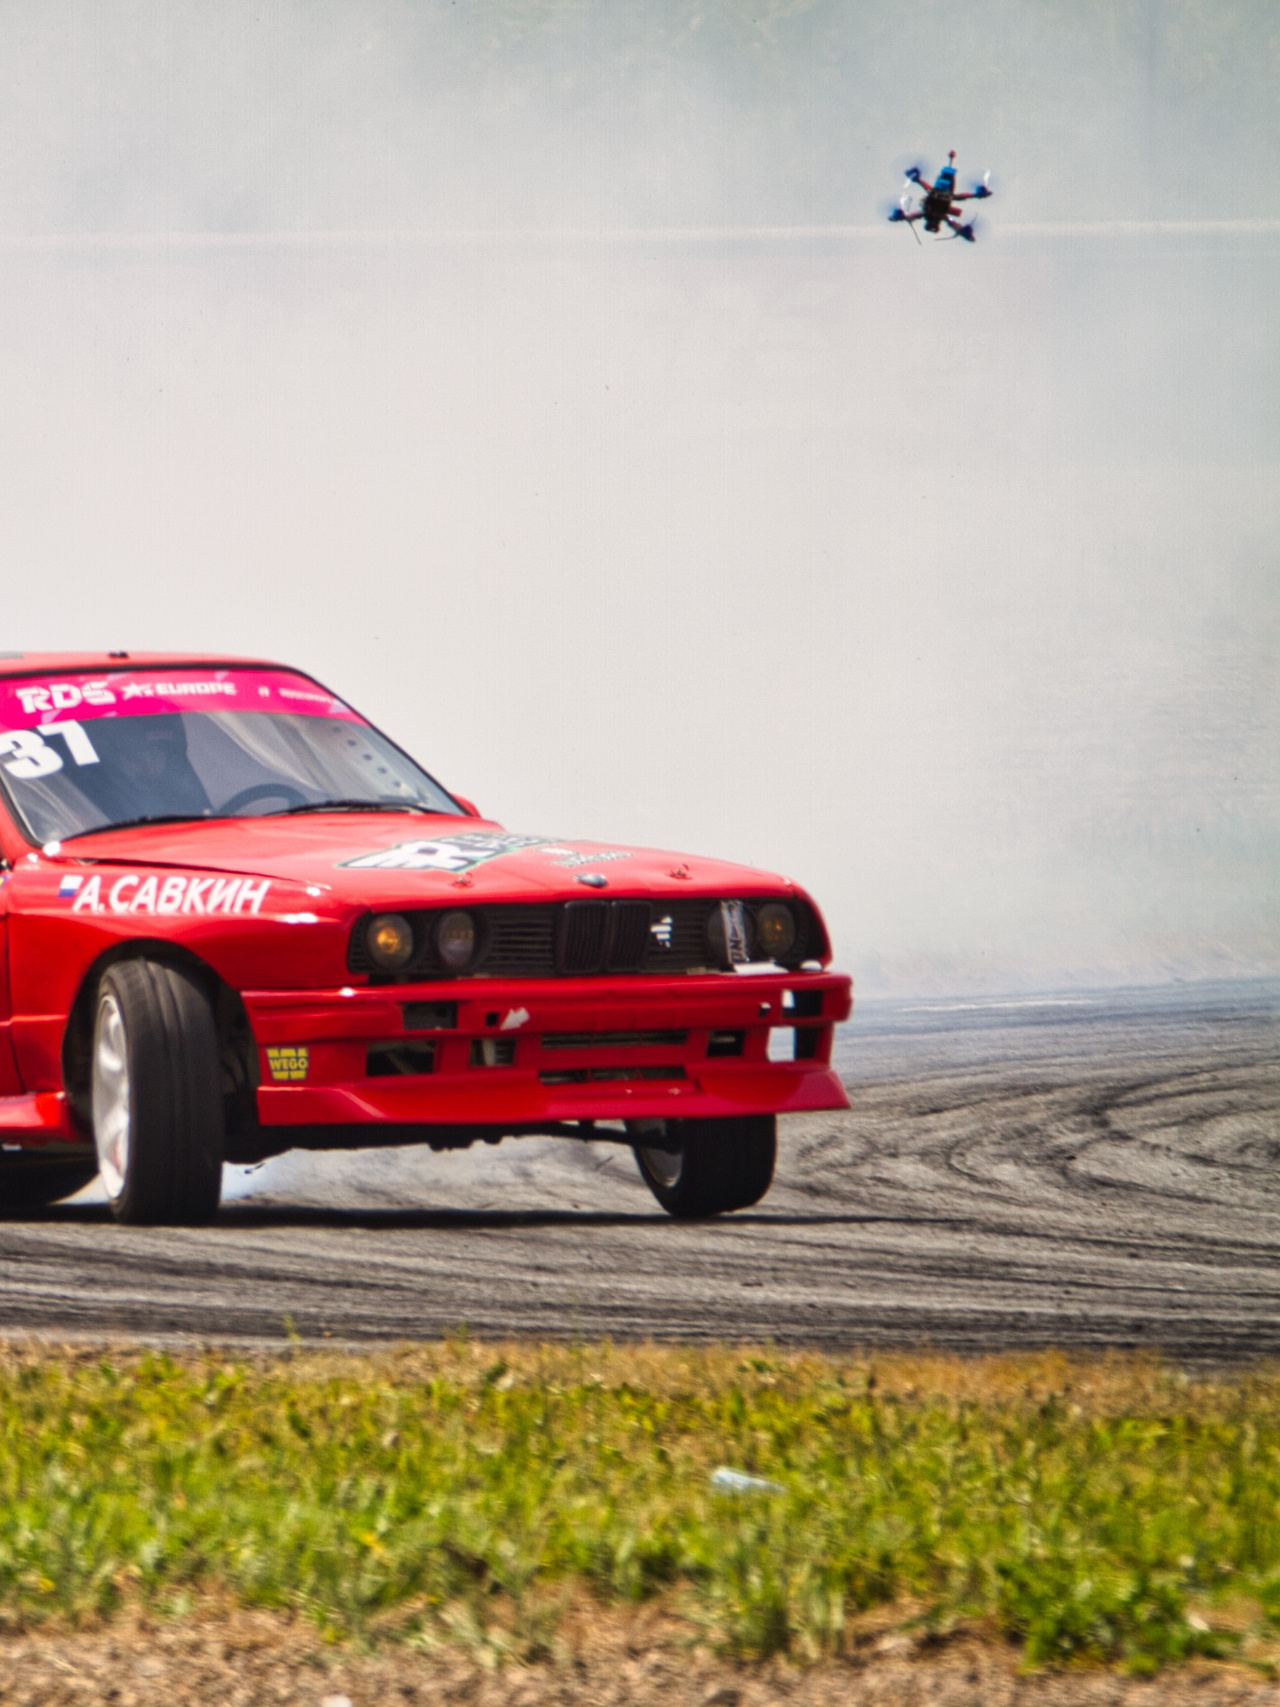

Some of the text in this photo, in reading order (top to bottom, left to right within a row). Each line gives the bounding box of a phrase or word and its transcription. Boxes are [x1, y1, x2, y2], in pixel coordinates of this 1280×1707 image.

[16, 681, 116, 714] RDS
[156, 682, 237, 696] EUROPE
[269, 1057, 308, 1070] WEGO
